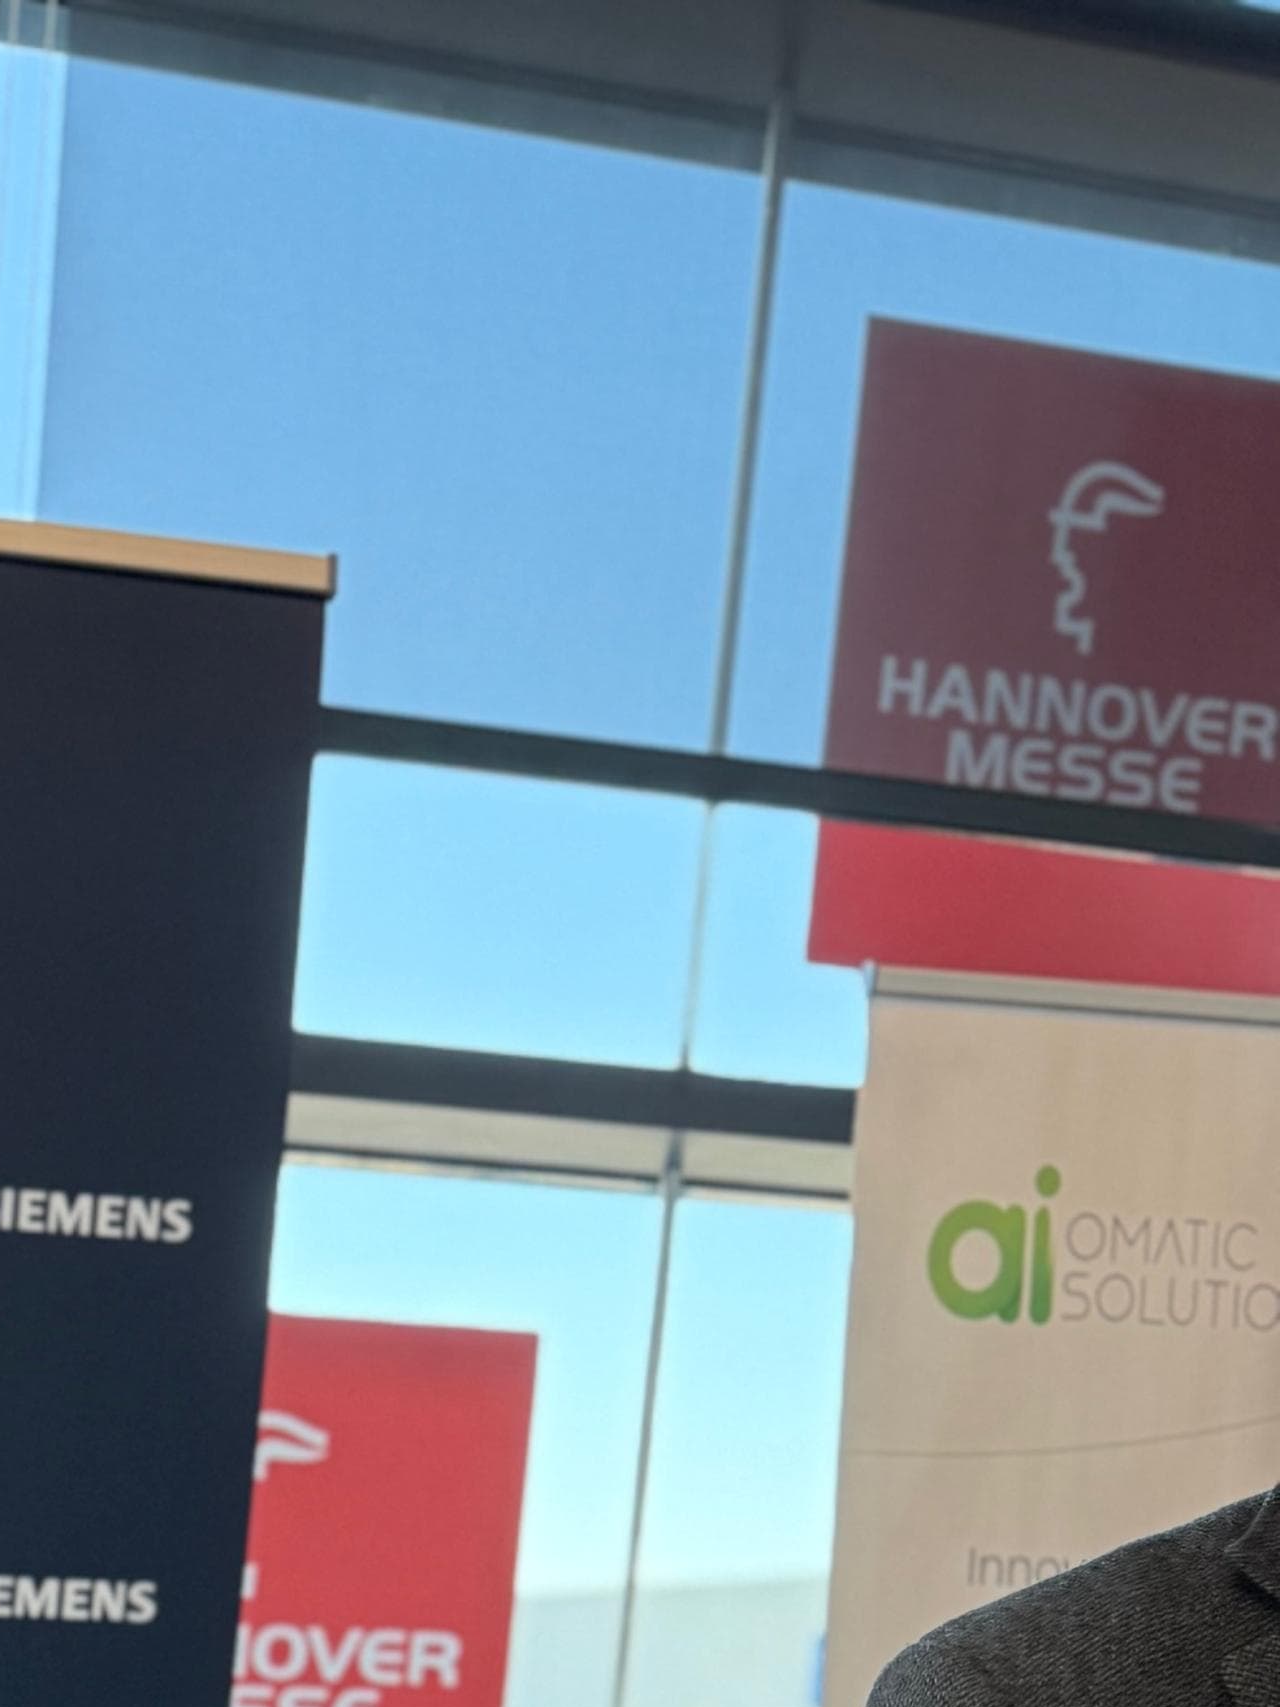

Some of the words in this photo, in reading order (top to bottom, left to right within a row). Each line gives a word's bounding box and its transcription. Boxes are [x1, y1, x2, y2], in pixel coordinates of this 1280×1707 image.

[877, 655, 1280, 762] HANNOVER
[944, 730, 1203, 812] MESSE
[1065, 1211, 1259, 1272] OMATIC
[234, 1622, 462, 1689] OVER
